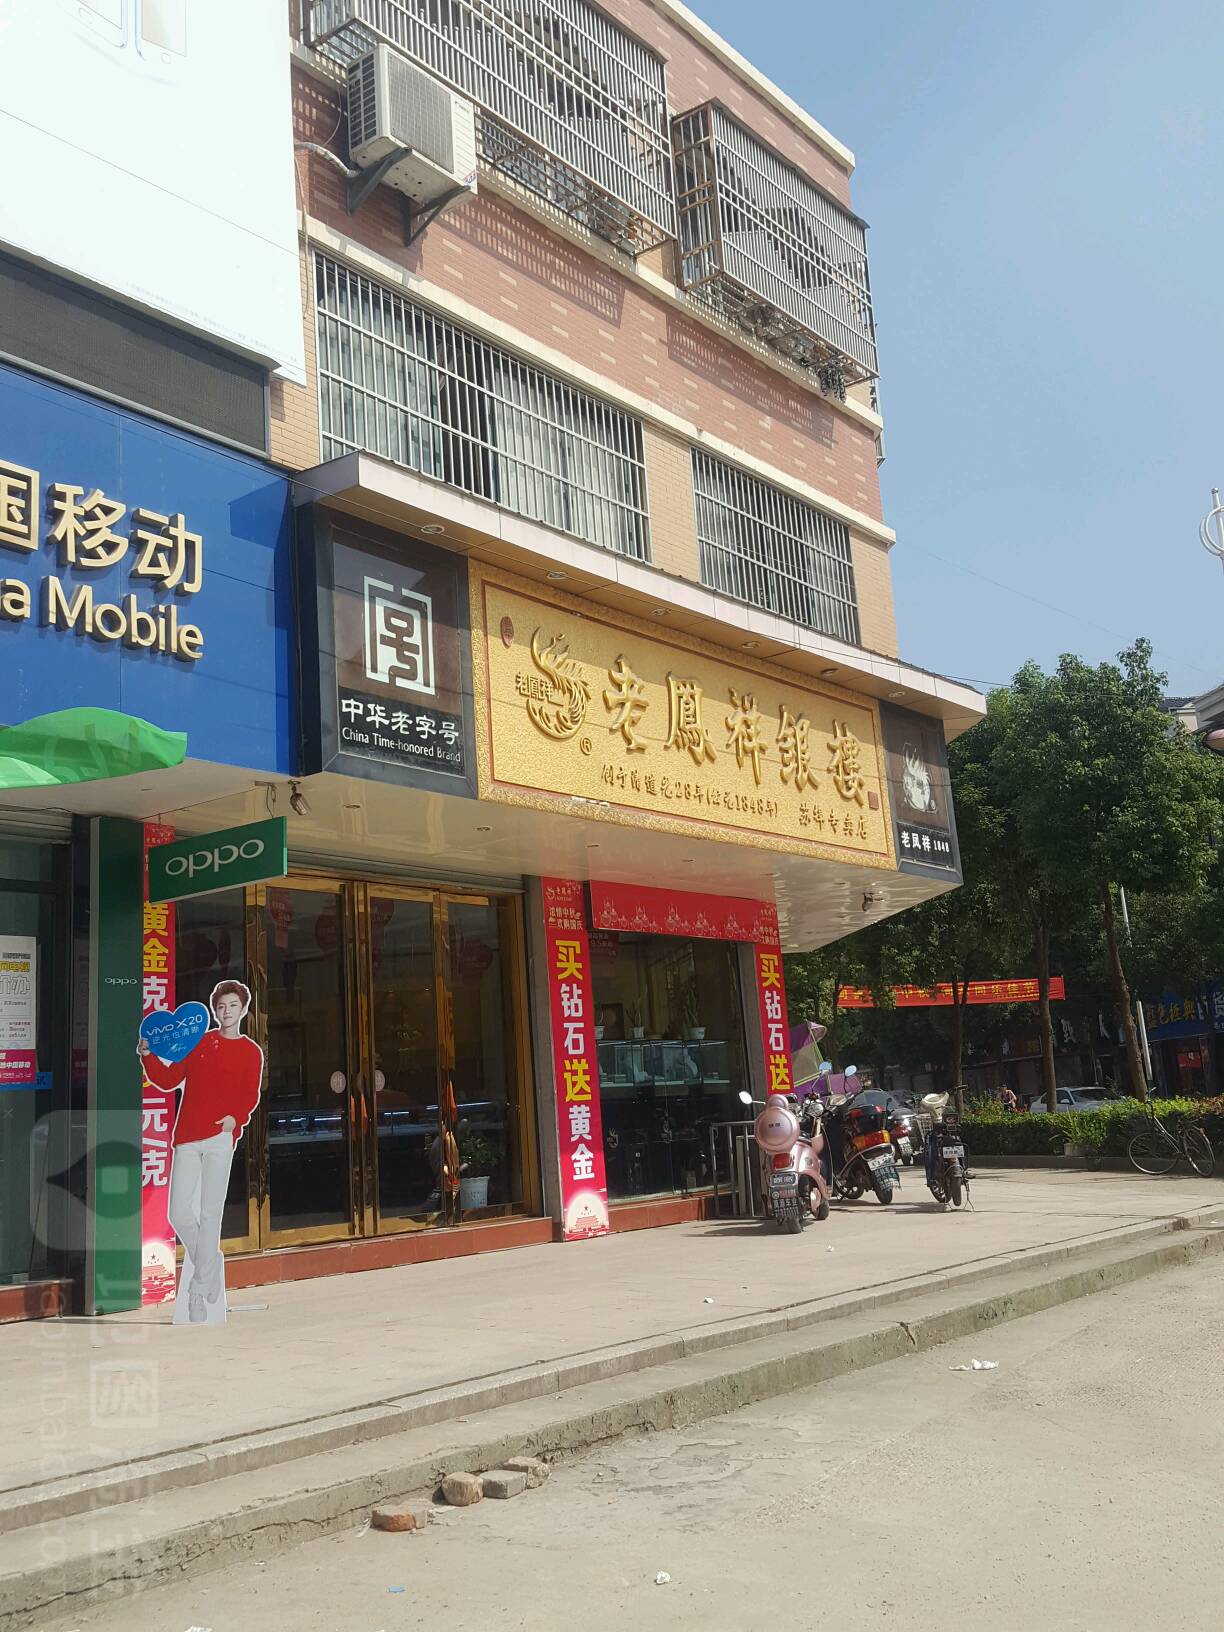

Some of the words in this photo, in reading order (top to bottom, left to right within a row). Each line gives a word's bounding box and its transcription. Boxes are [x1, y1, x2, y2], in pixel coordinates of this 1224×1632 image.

[0, 459, 203, 594] 国移动
[40, 575, 204, 661] Mobile
[341, 698, 459, 745] 中华老字号
[342, 726, 370, 744] China
[372, 732, 434, 757] Time-honored
[437, 746, 460, 762] Brand
[900, 830, 931, 852] 老凤祥
[933, 839, 950, 853] 1848
[147, 1024, 174, 1036] vivo
[176, 1014, 203, 1029] X20
[759, 953, 791, 1091] 买钻石送
[555, 939, 595, 1181] 买钻石送黄金
